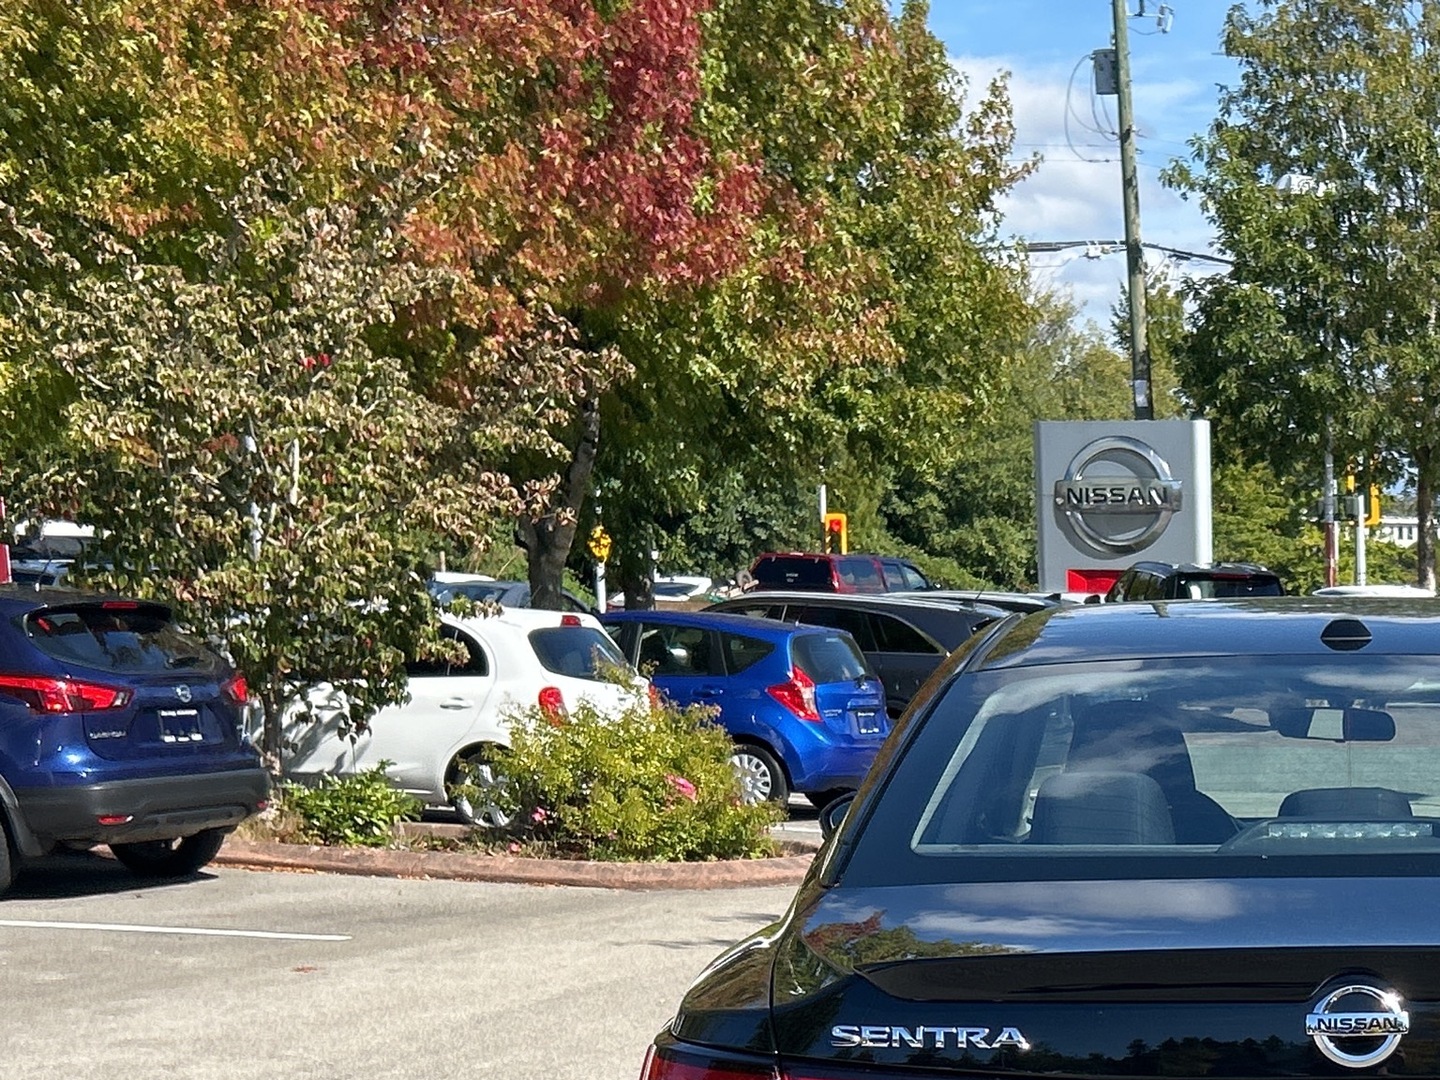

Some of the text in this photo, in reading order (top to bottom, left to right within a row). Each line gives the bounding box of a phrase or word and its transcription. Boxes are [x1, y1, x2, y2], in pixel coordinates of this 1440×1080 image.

[1066, 487, 1167, 505] NISSAN
[1317, 1017, 1398, 1031] NISSAN
[831, 1025, 1031, 1050] SENTRA
